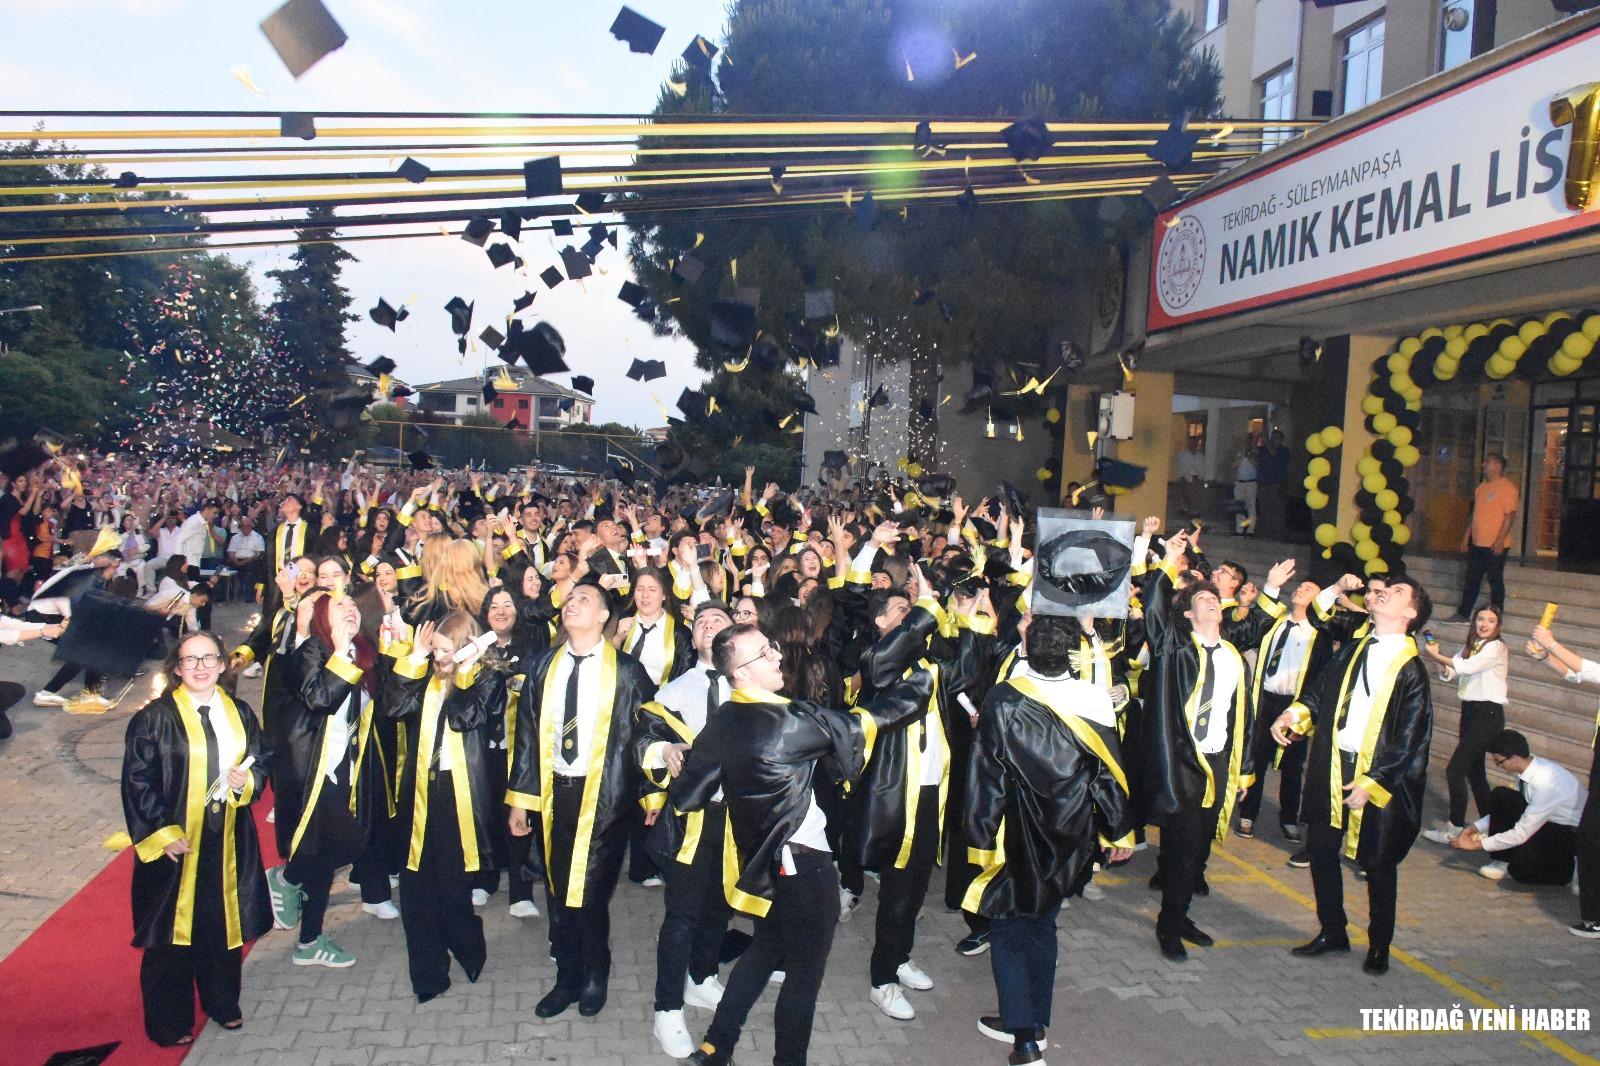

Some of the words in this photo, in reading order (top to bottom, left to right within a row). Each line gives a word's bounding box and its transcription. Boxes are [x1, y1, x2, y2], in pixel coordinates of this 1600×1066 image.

[1220, 211, 1321, 285] NAMIK
[1329, 163, 1472, 253] KEMAL
[1486, 125, 1564, 208] LİS
[1222, 194, 1276, 231] TEKİRDAĞ
[1286, 149, 1402, 208] SÜLEYMANPAŞA
